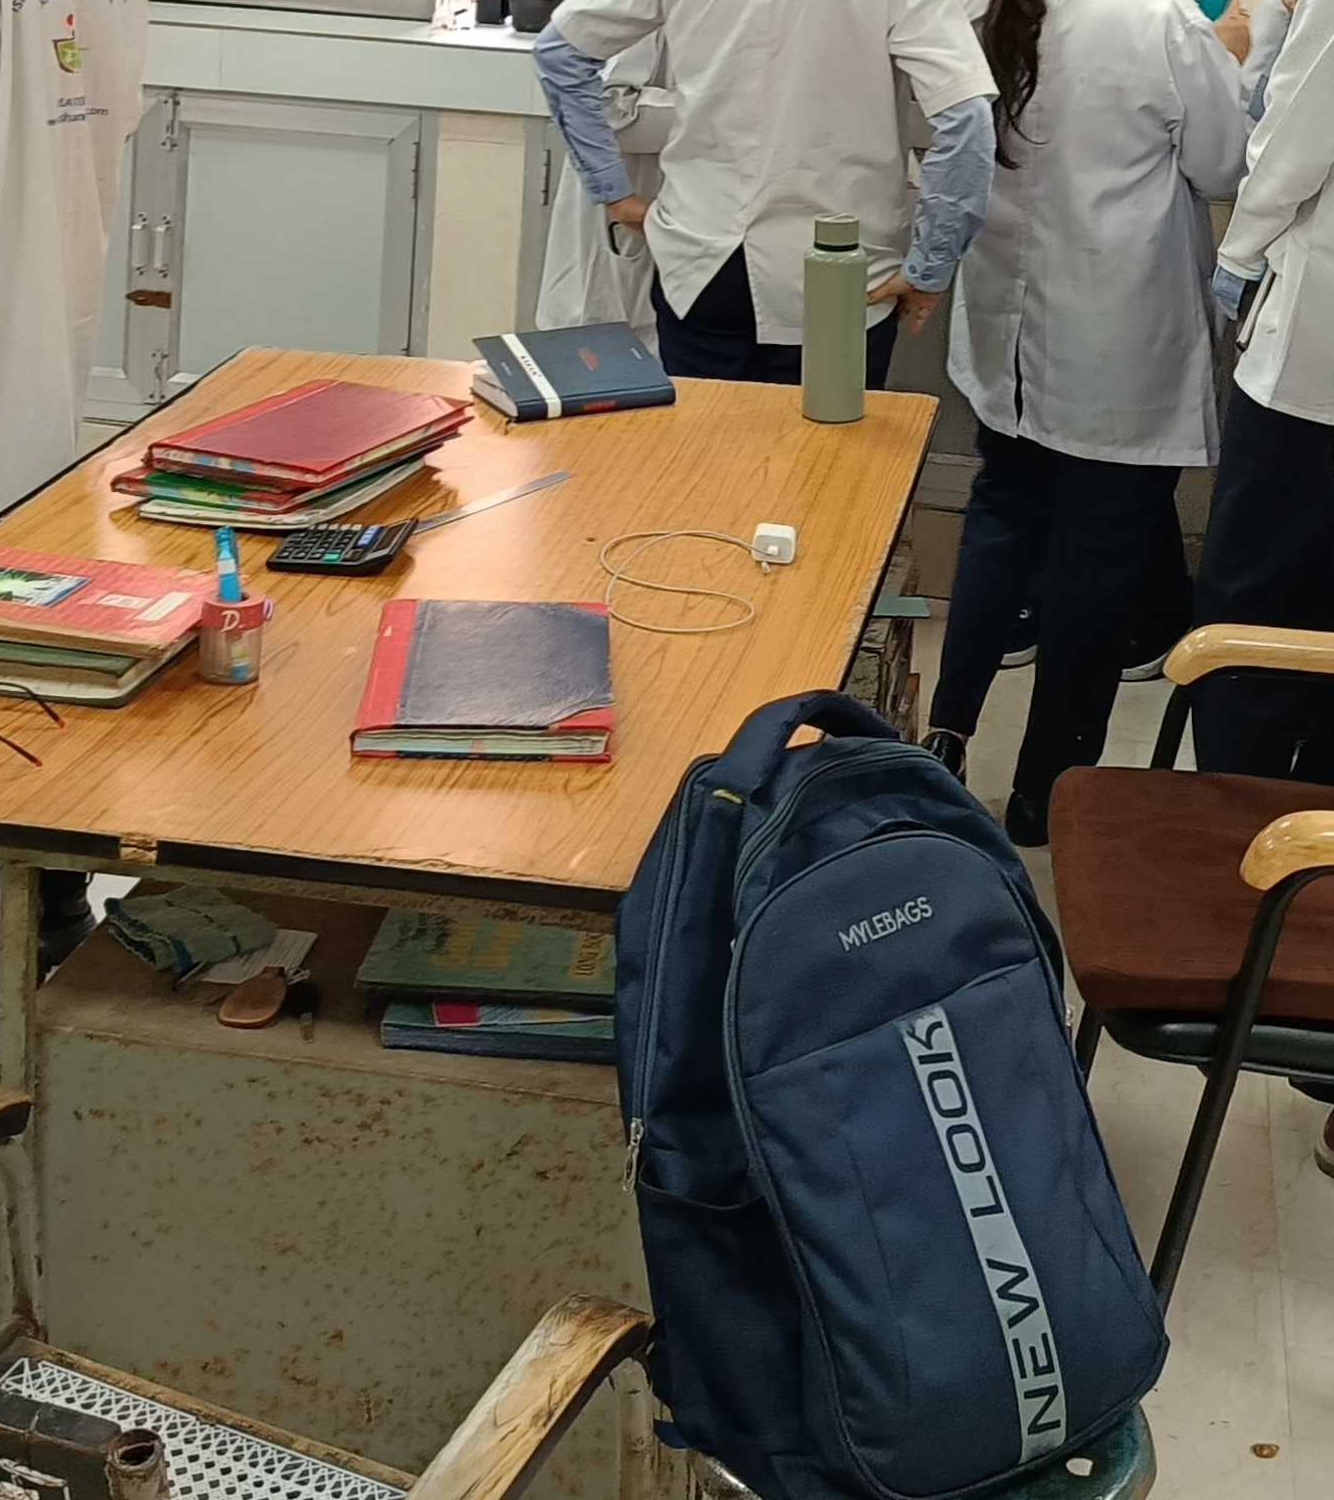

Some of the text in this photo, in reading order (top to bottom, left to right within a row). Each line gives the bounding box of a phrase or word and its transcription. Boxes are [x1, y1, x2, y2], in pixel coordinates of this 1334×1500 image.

[838, 896, 933, 952] MYLEBAGS
[906, 1020, 1062, 1436] NEW LOOK
